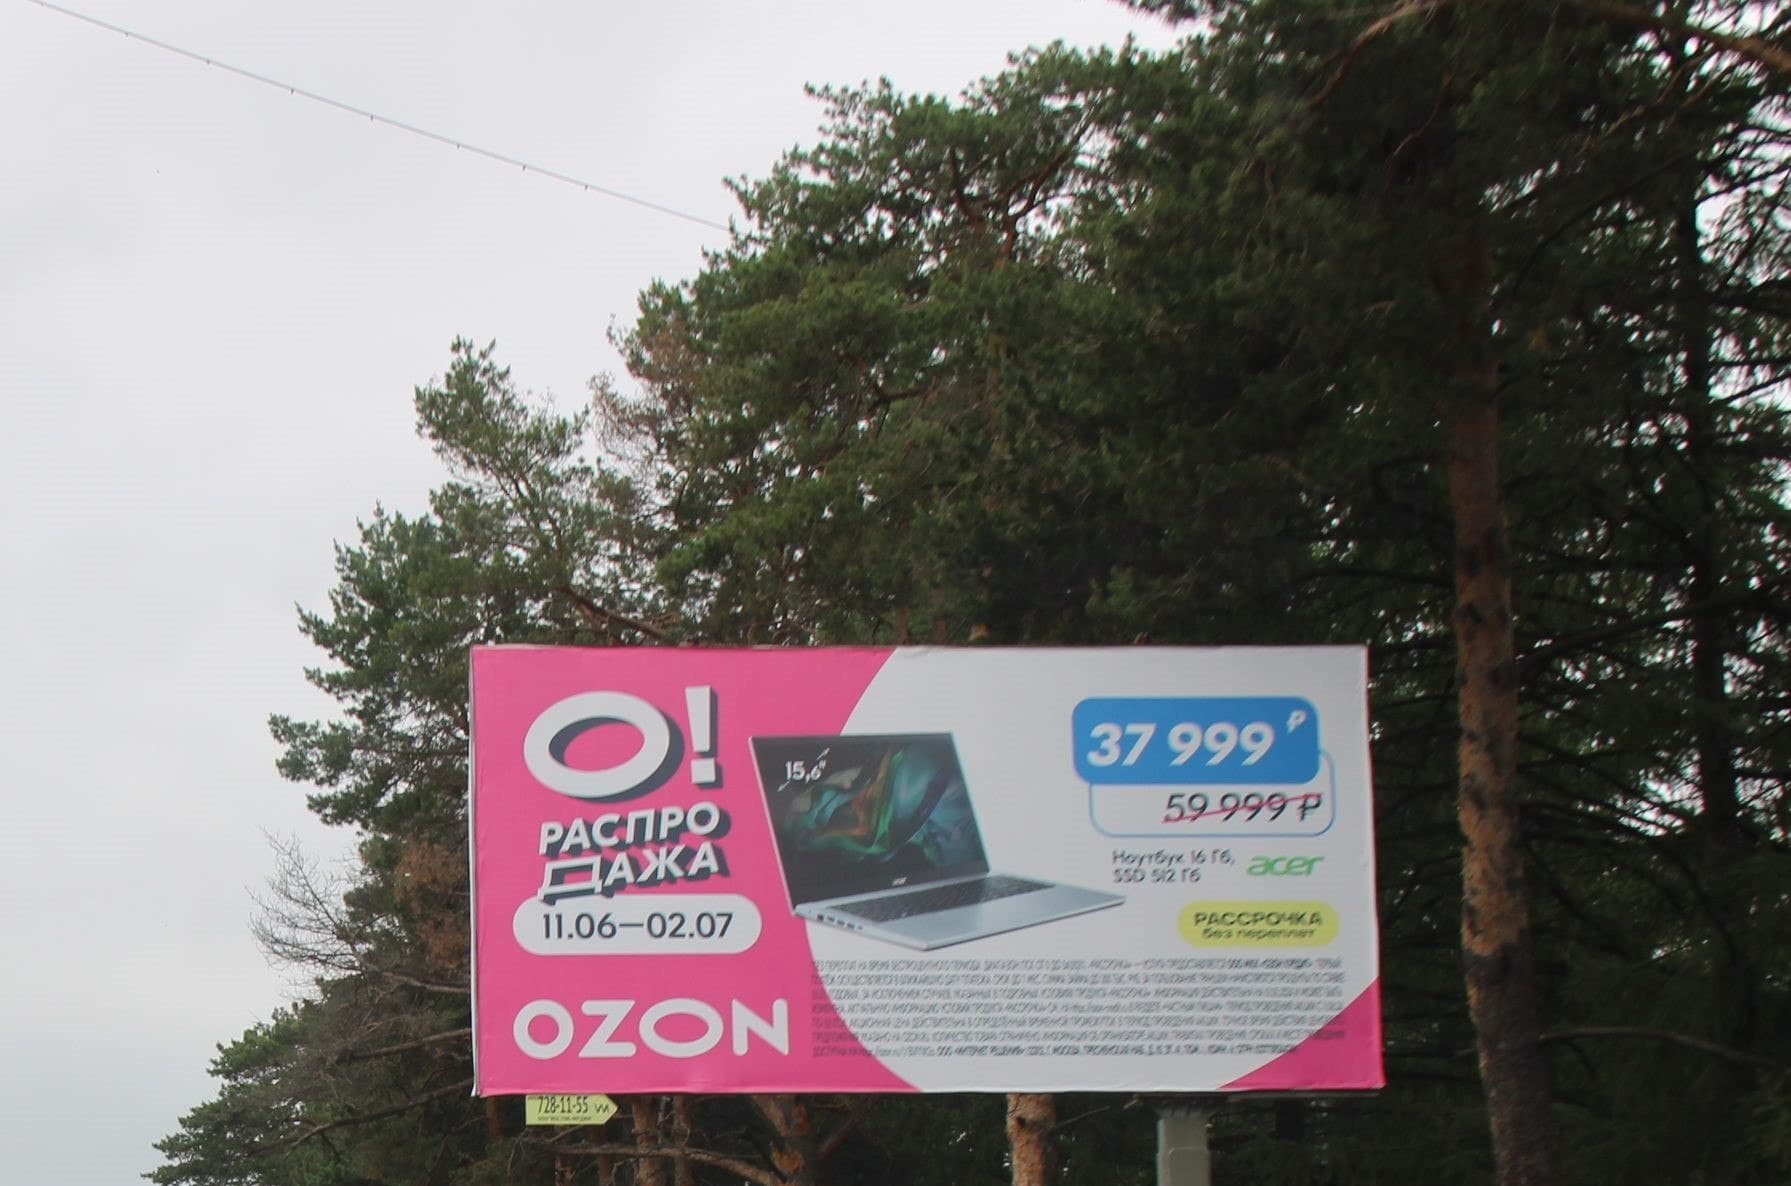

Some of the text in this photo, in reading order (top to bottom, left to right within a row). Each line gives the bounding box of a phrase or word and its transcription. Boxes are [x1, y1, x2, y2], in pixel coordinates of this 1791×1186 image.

[1087, 722, 1157, 768] 37
[1167, 721, 1275, 768] 999
[1164, 792, 1209, 822] 59
[1220, 792, 1288, 822] 999
[538, 801, 720, 856] РАСПРО
[536, 841, 720, 900] ДАЖА
[1112, 849, 1184, 868] Ноутбук
[1247, 855, 1325, 877] acer
[1113, 867, 1146, 883] SSD
[1151, 867, 1176, 883] 512
[1193, 911, 1322, 926] РАССРОЧКА
[513, 997, 789, 1060] OZON
[538, 1096, 589, 1114] 728-11-55
